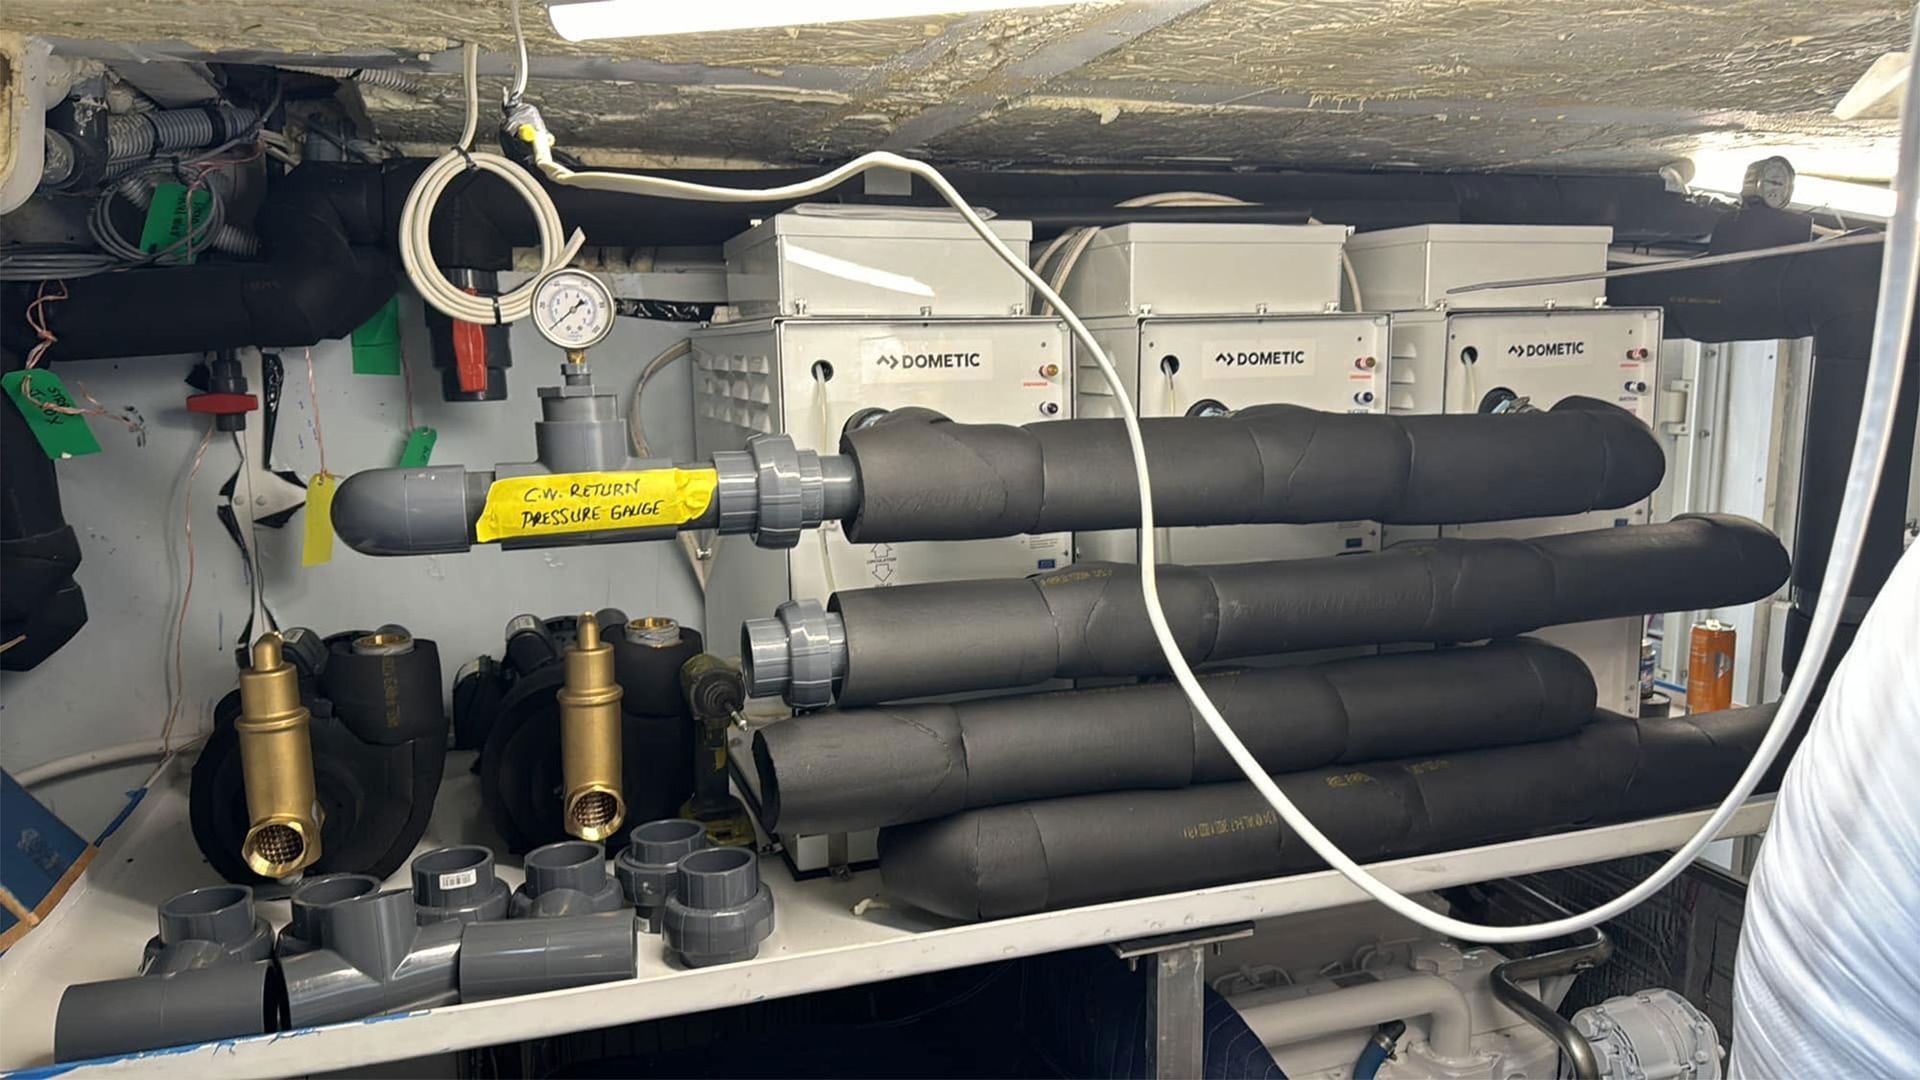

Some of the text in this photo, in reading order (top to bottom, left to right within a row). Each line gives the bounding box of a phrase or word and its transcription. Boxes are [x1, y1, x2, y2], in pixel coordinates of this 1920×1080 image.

[1526, 341, 1585, 357] DOMETIC
[902, 353, 980, 369] DOMETIC
[1236, 350, 1305, 366] DOMETIC
[524, 478, 640, 503] C.W. RETURN
[521, 500, 665, 529] PRESSURE GAUGE
